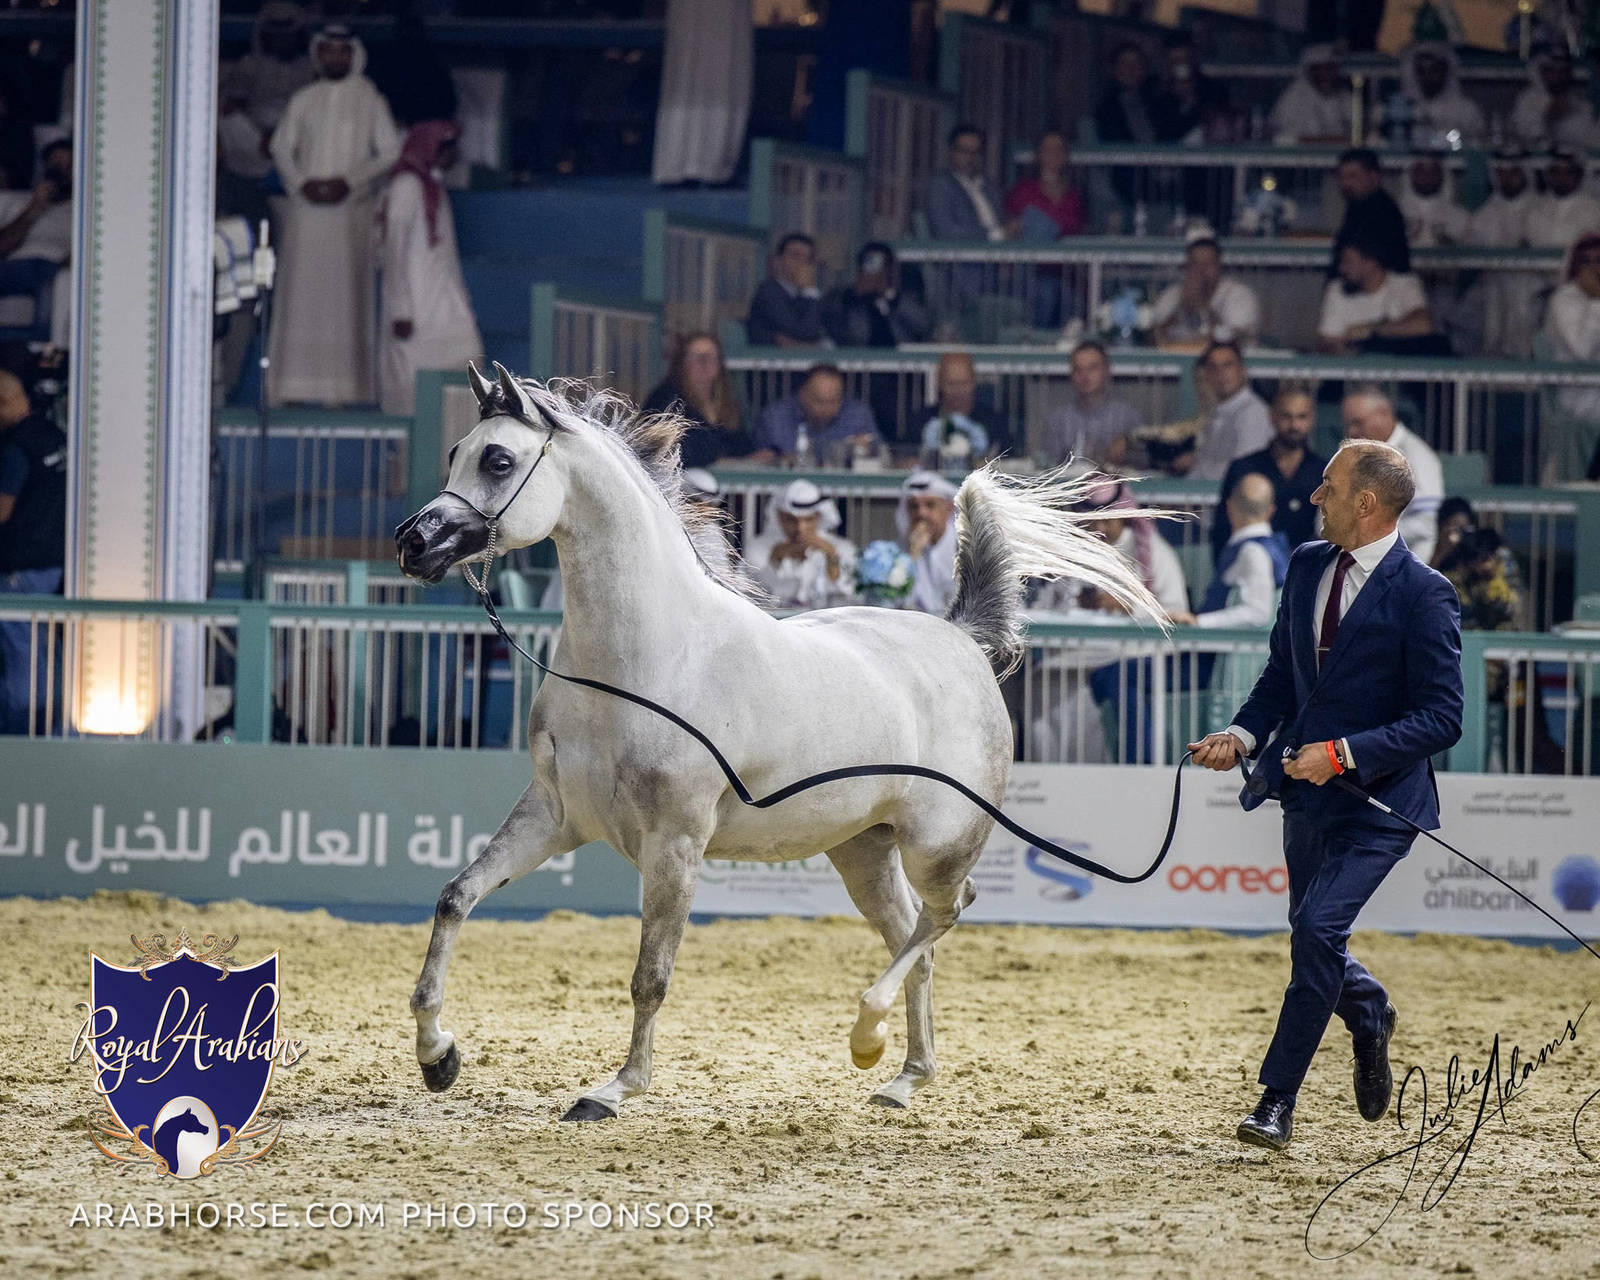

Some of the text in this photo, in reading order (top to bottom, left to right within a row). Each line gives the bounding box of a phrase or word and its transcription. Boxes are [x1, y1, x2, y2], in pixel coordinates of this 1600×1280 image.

[0, 802, 576, 887] بلة العالم للخيل ال
